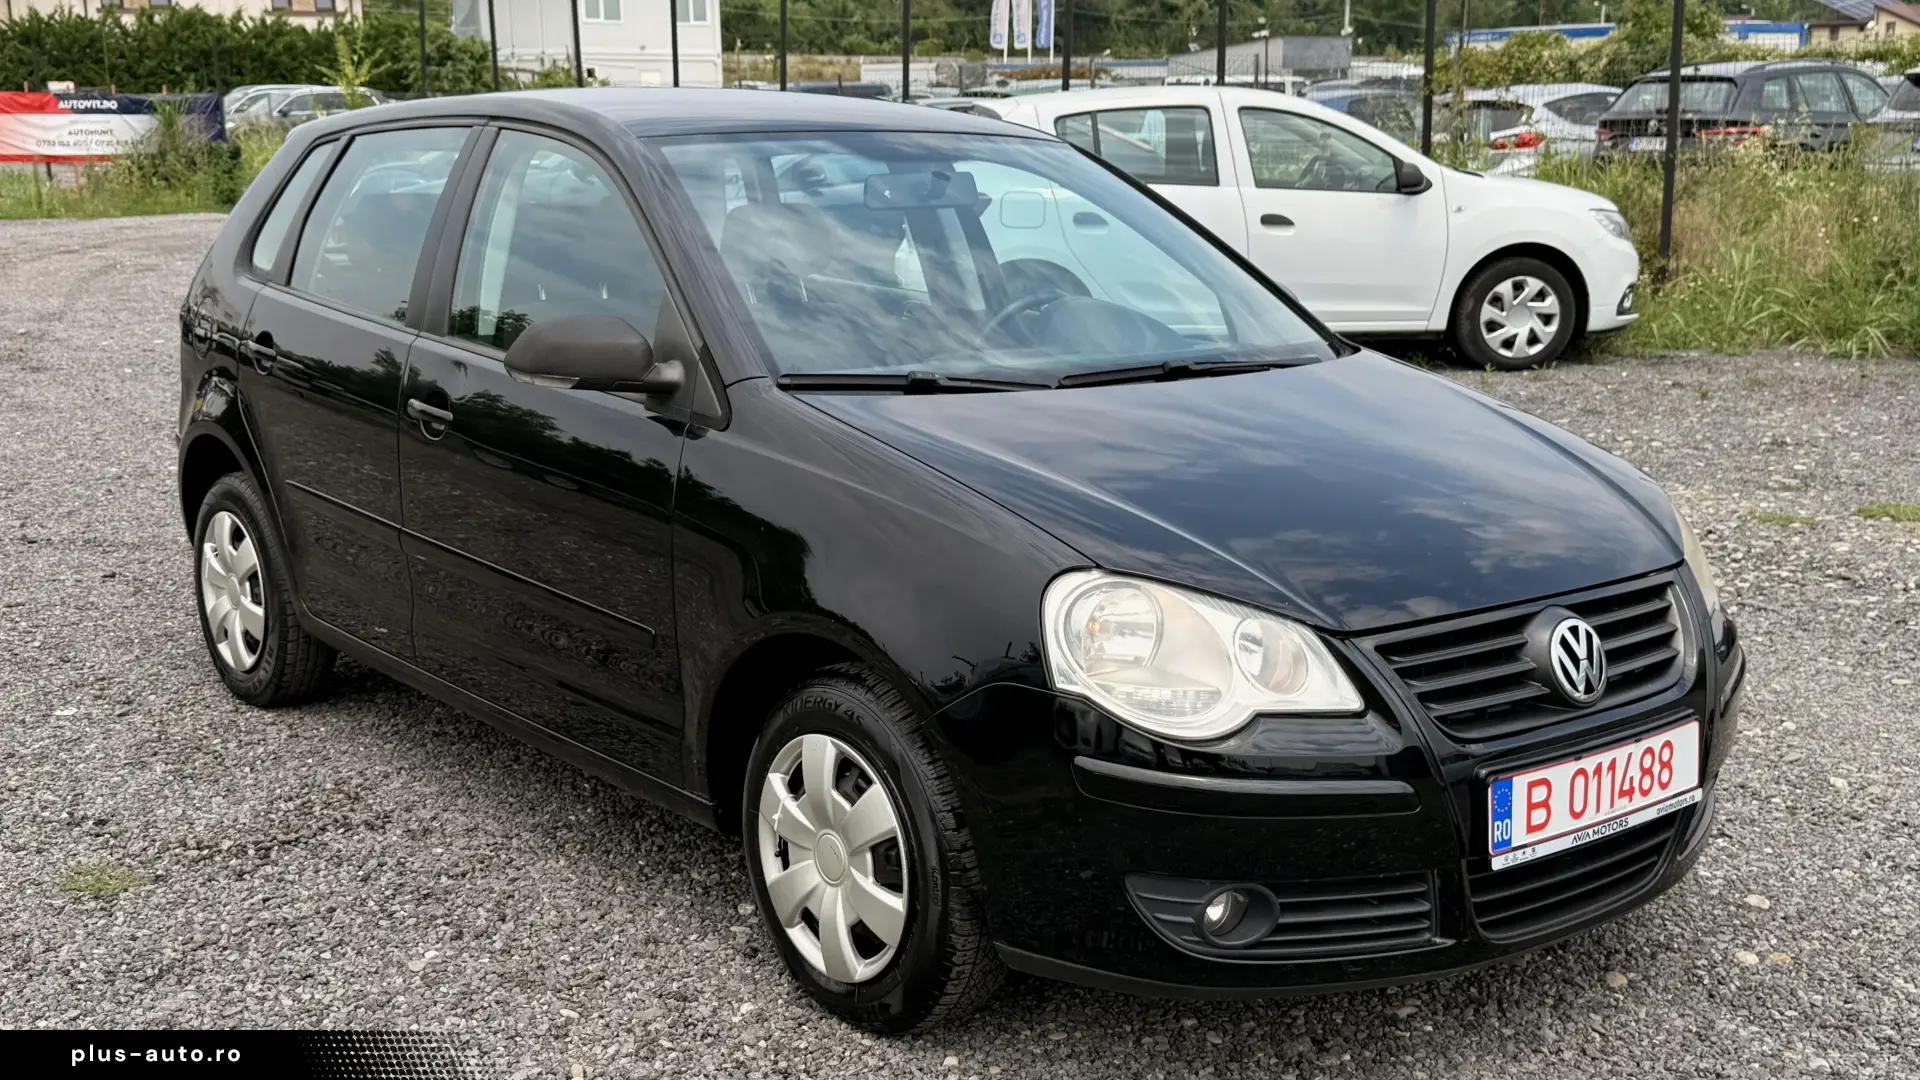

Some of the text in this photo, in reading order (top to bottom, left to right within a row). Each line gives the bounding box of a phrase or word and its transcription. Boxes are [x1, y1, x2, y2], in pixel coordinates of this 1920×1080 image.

[57, 99, 118, 110] AUTOVIT.RO
[1525, 739, 1674, 835] B 011488
[1493, 818, 1512, 844] RO
[1592, 817, 1629, 838] MOTORS
